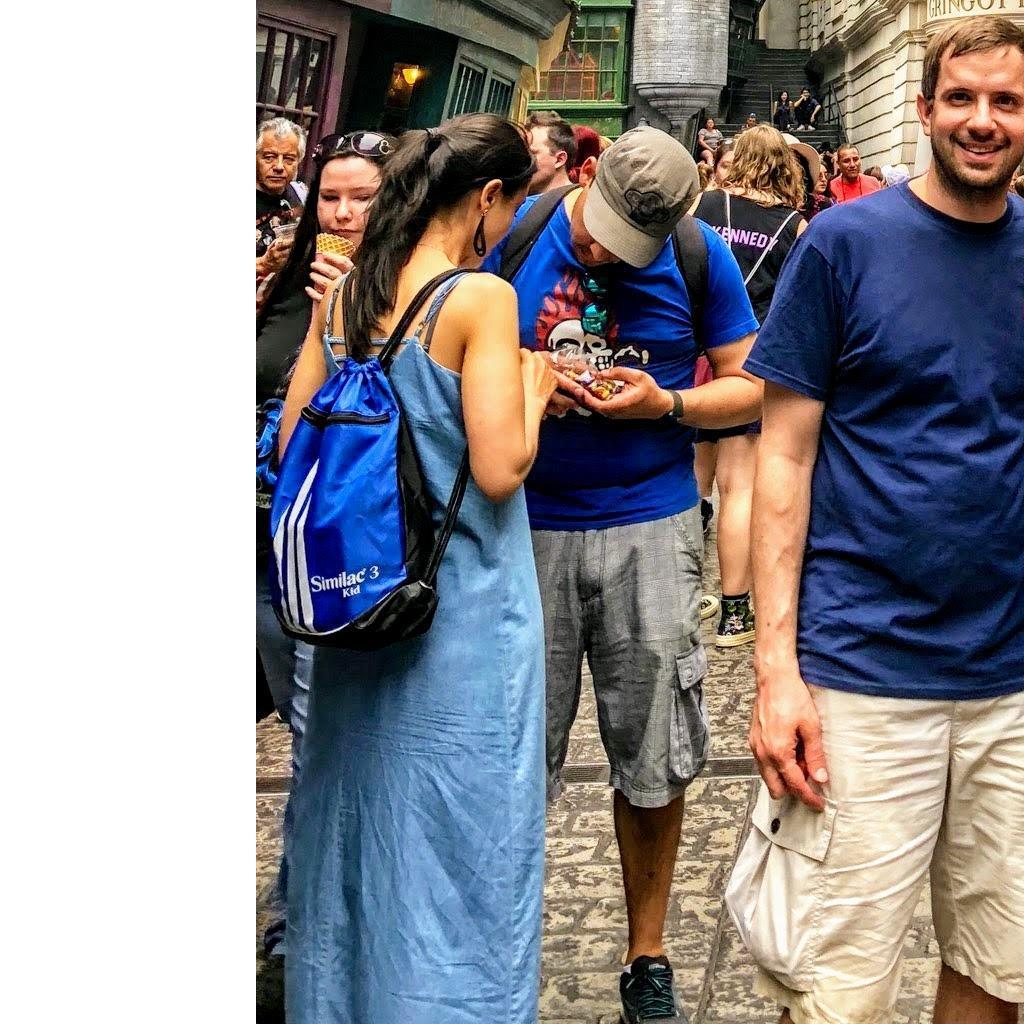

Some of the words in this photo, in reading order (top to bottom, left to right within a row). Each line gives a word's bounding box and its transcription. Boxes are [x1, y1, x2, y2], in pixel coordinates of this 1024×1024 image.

[310, 569, 366, 592] Similac
[369, 565, 380, 580] 3
[342, 585, 361, 598] Kid
